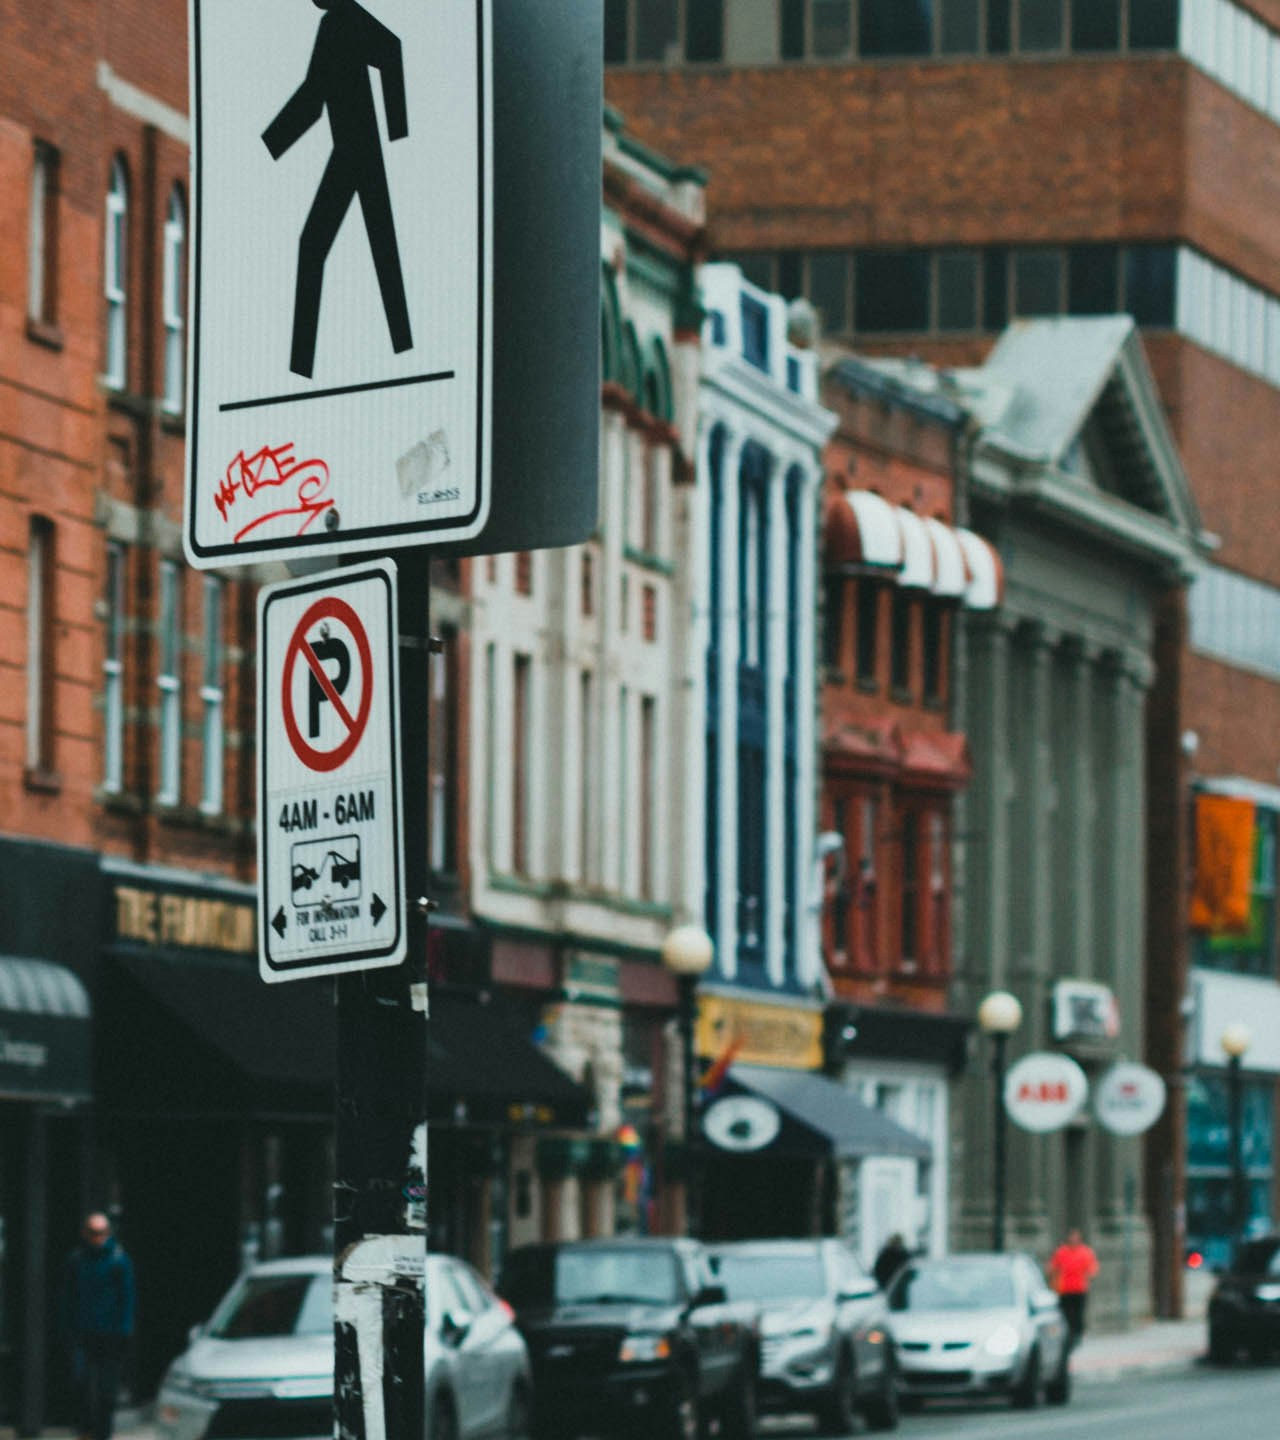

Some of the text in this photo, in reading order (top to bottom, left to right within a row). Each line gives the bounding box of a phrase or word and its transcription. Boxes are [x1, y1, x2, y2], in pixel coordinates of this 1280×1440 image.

[309, 637, 351, 739] P
[278, 799, 318, 833] 4AM
[334, 790, 376, 826] 6AM
